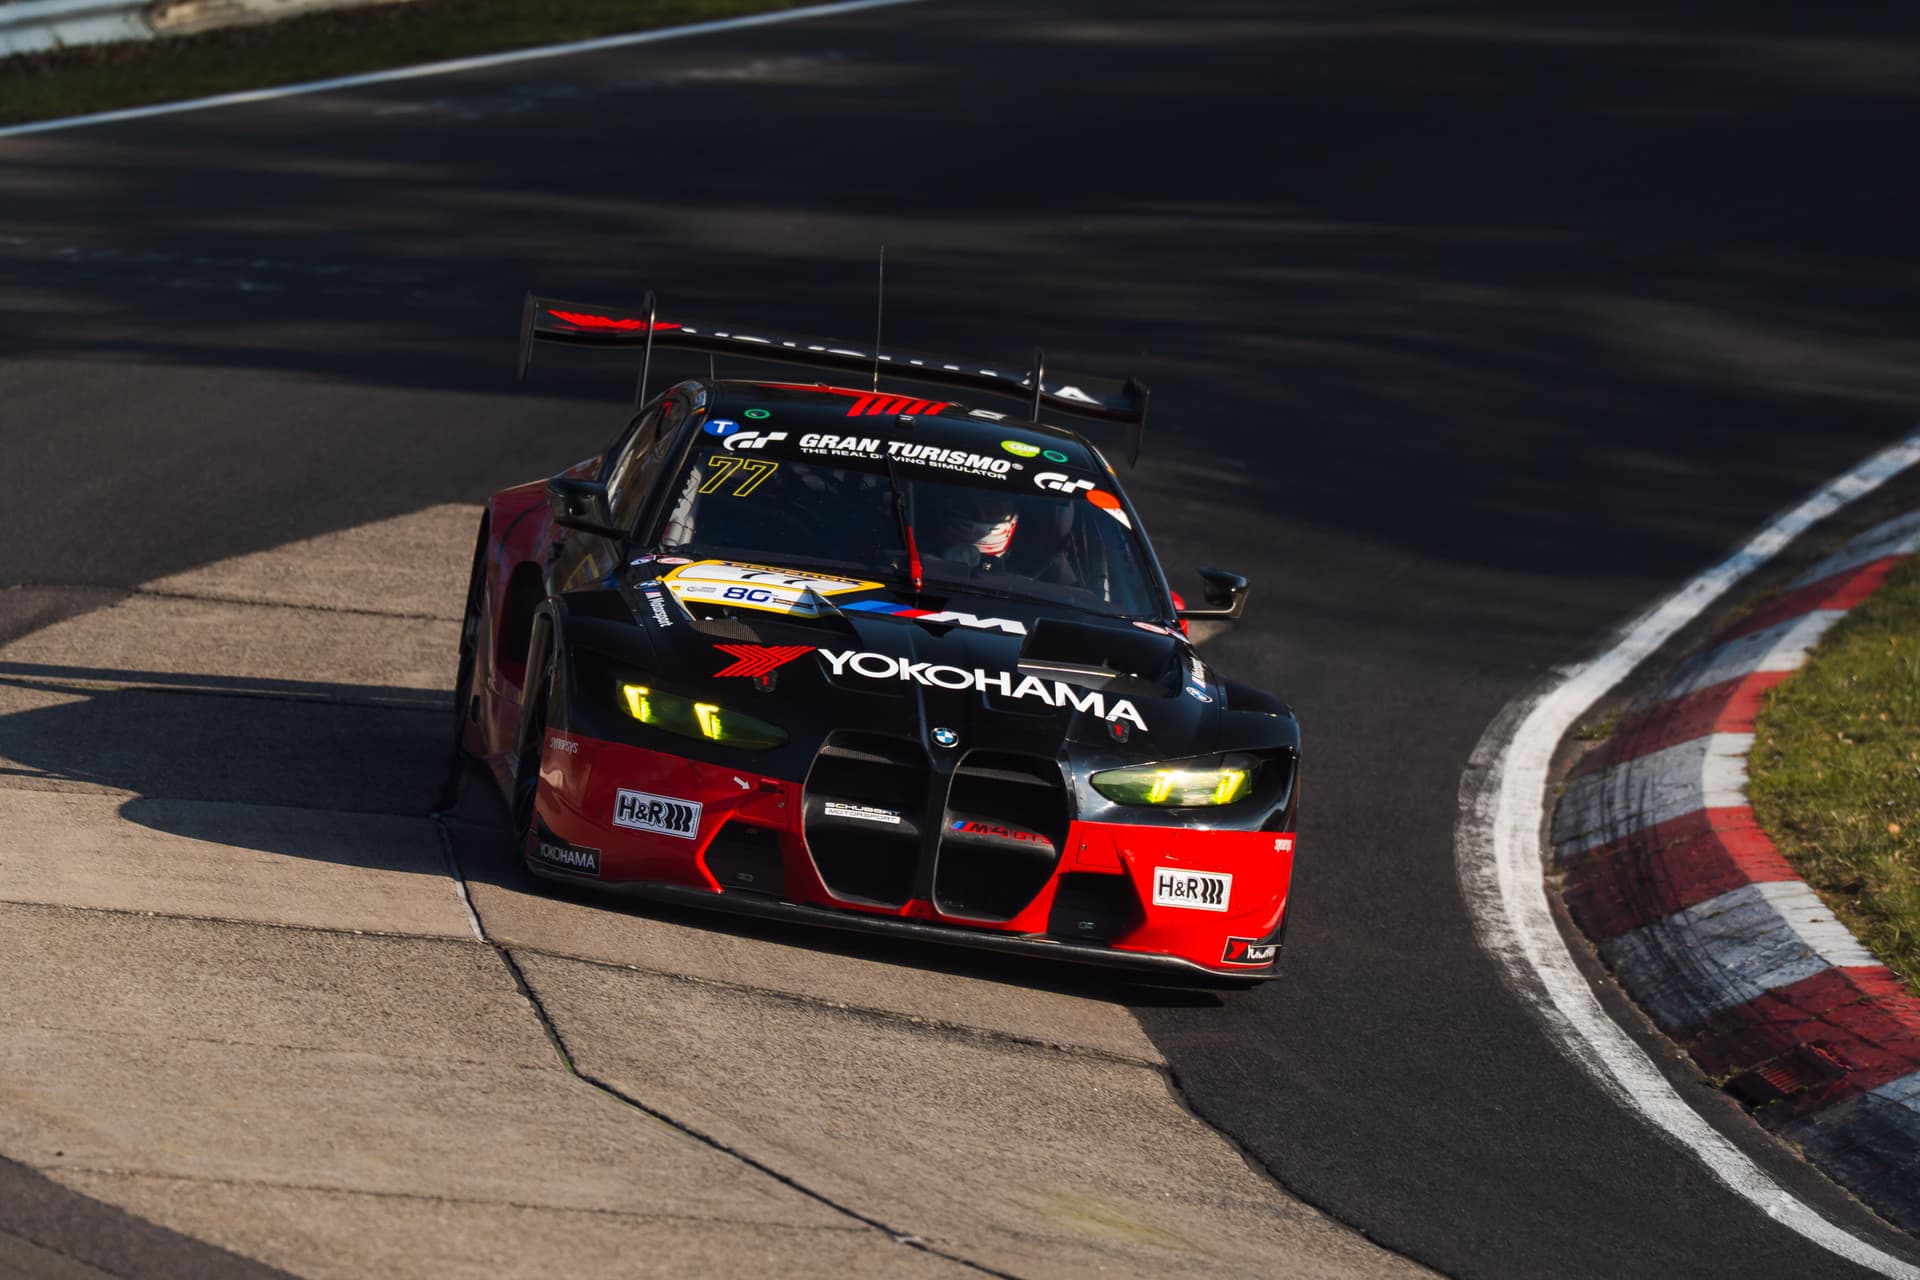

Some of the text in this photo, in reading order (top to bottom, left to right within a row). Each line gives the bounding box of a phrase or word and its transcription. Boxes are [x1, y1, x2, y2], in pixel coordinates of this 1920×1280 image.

[799, 433, 881, 453] GRAN
[699, 455, 779, 497] 77
[800, 447, 829, 456] THE
[830, 449, 866, 459] REAL
[928, 461, 1007, 480] SIMULATOR
[650, 596, 675, 628] Motorsport
[816, 648, 1149, 732] YOKOHAMA
[618, 795, 665, 826] H&R
[825, 802, 901, 816] SCHUBERT
[827, 809, 897, 822] MOTORSPORT
[1158, 875, 1199, 900] H&R
